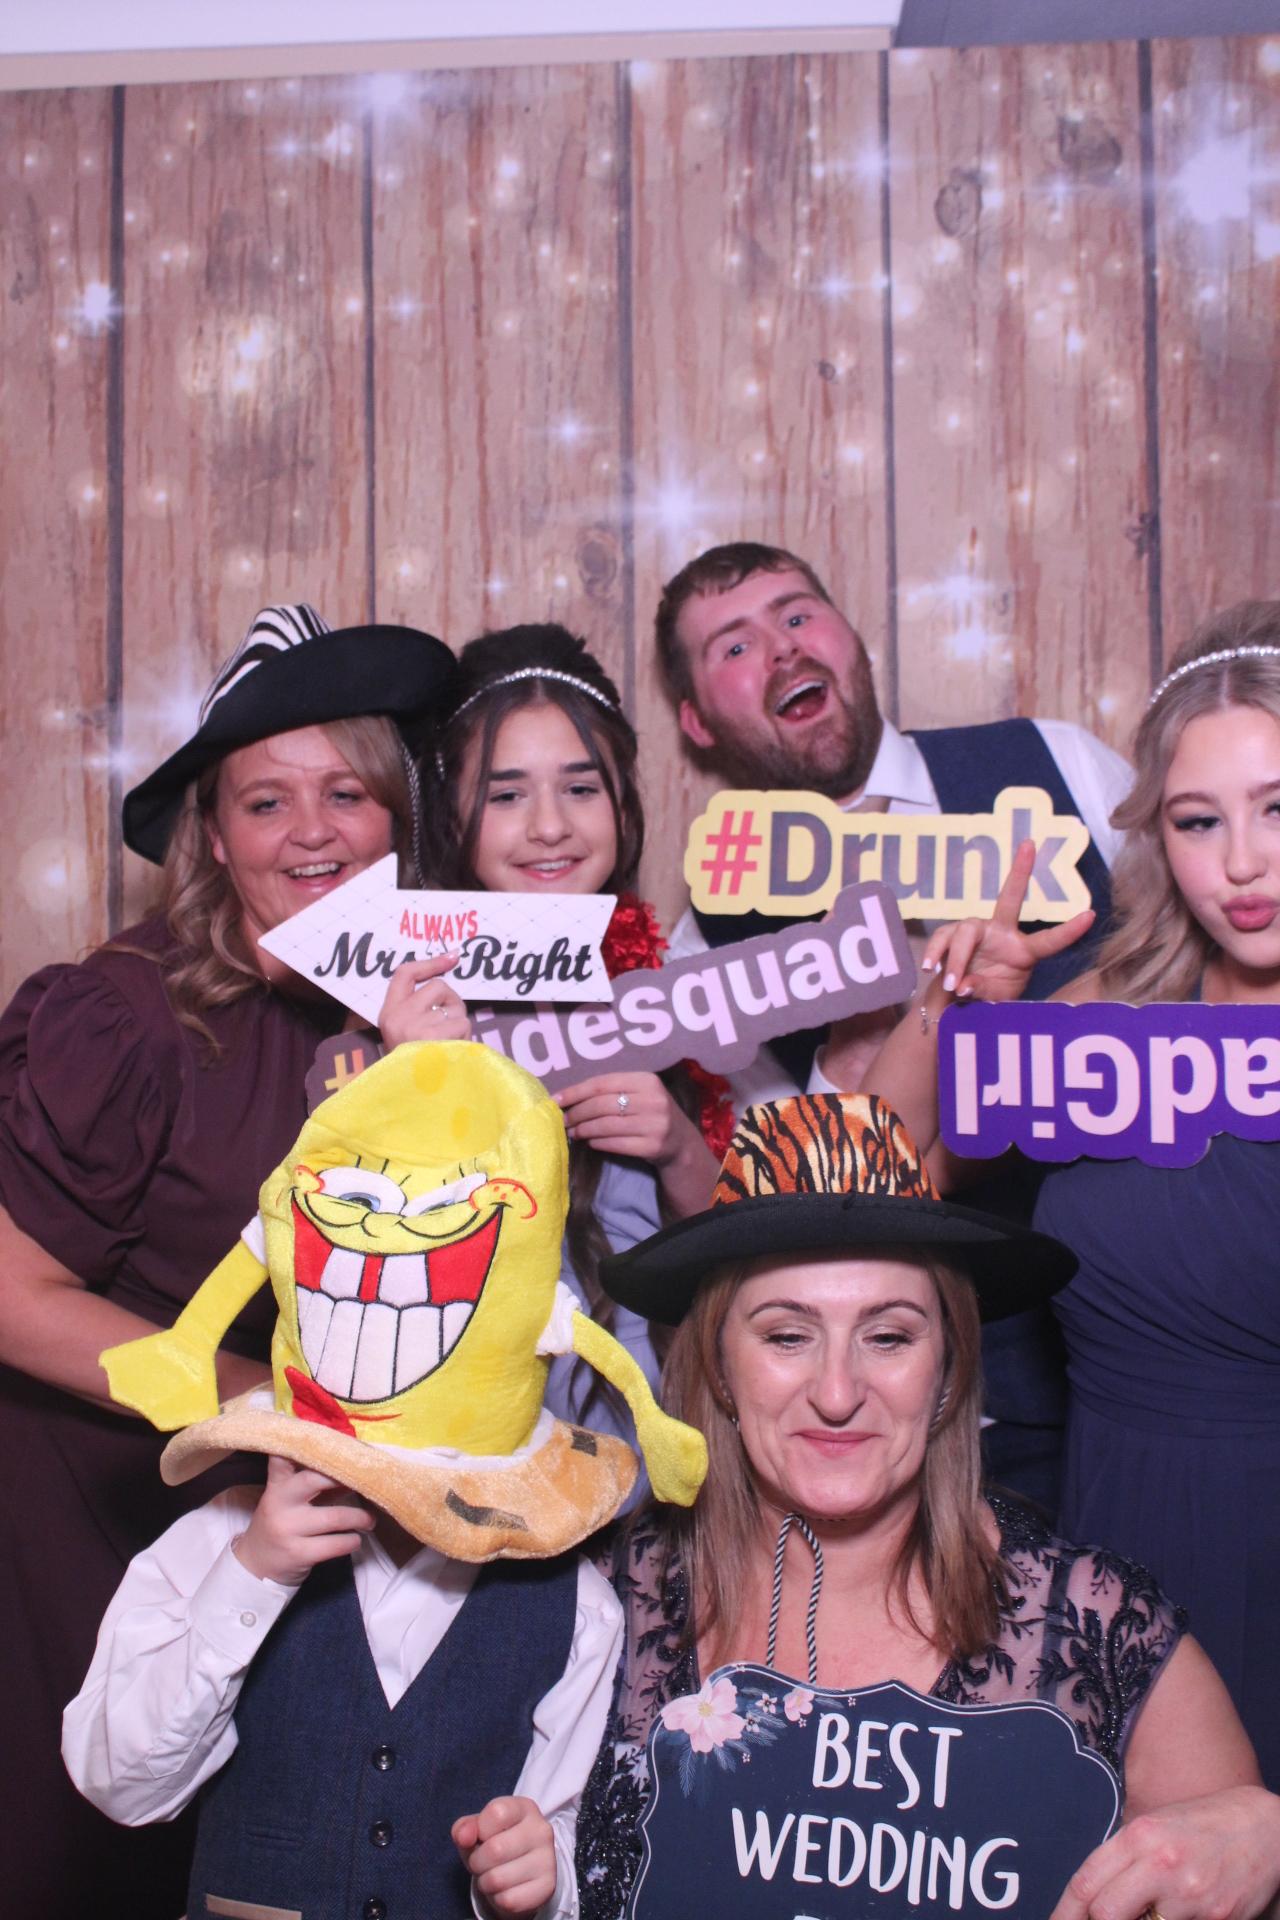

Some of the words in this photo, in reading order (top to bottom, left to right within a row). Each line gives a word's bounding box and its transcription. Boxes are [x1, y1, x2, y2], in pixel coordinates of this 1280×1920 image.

[700, 808, 1069, 902] #Drunk
[399, 909, 479, 942] ALWAYS
[452, 934, 593, 996] Right
[953, 1032, 1280, 1144] adGirl
[812, 1712, 963, 1809] BEST
[731, 1807, 1020, 1910] WEDDING
